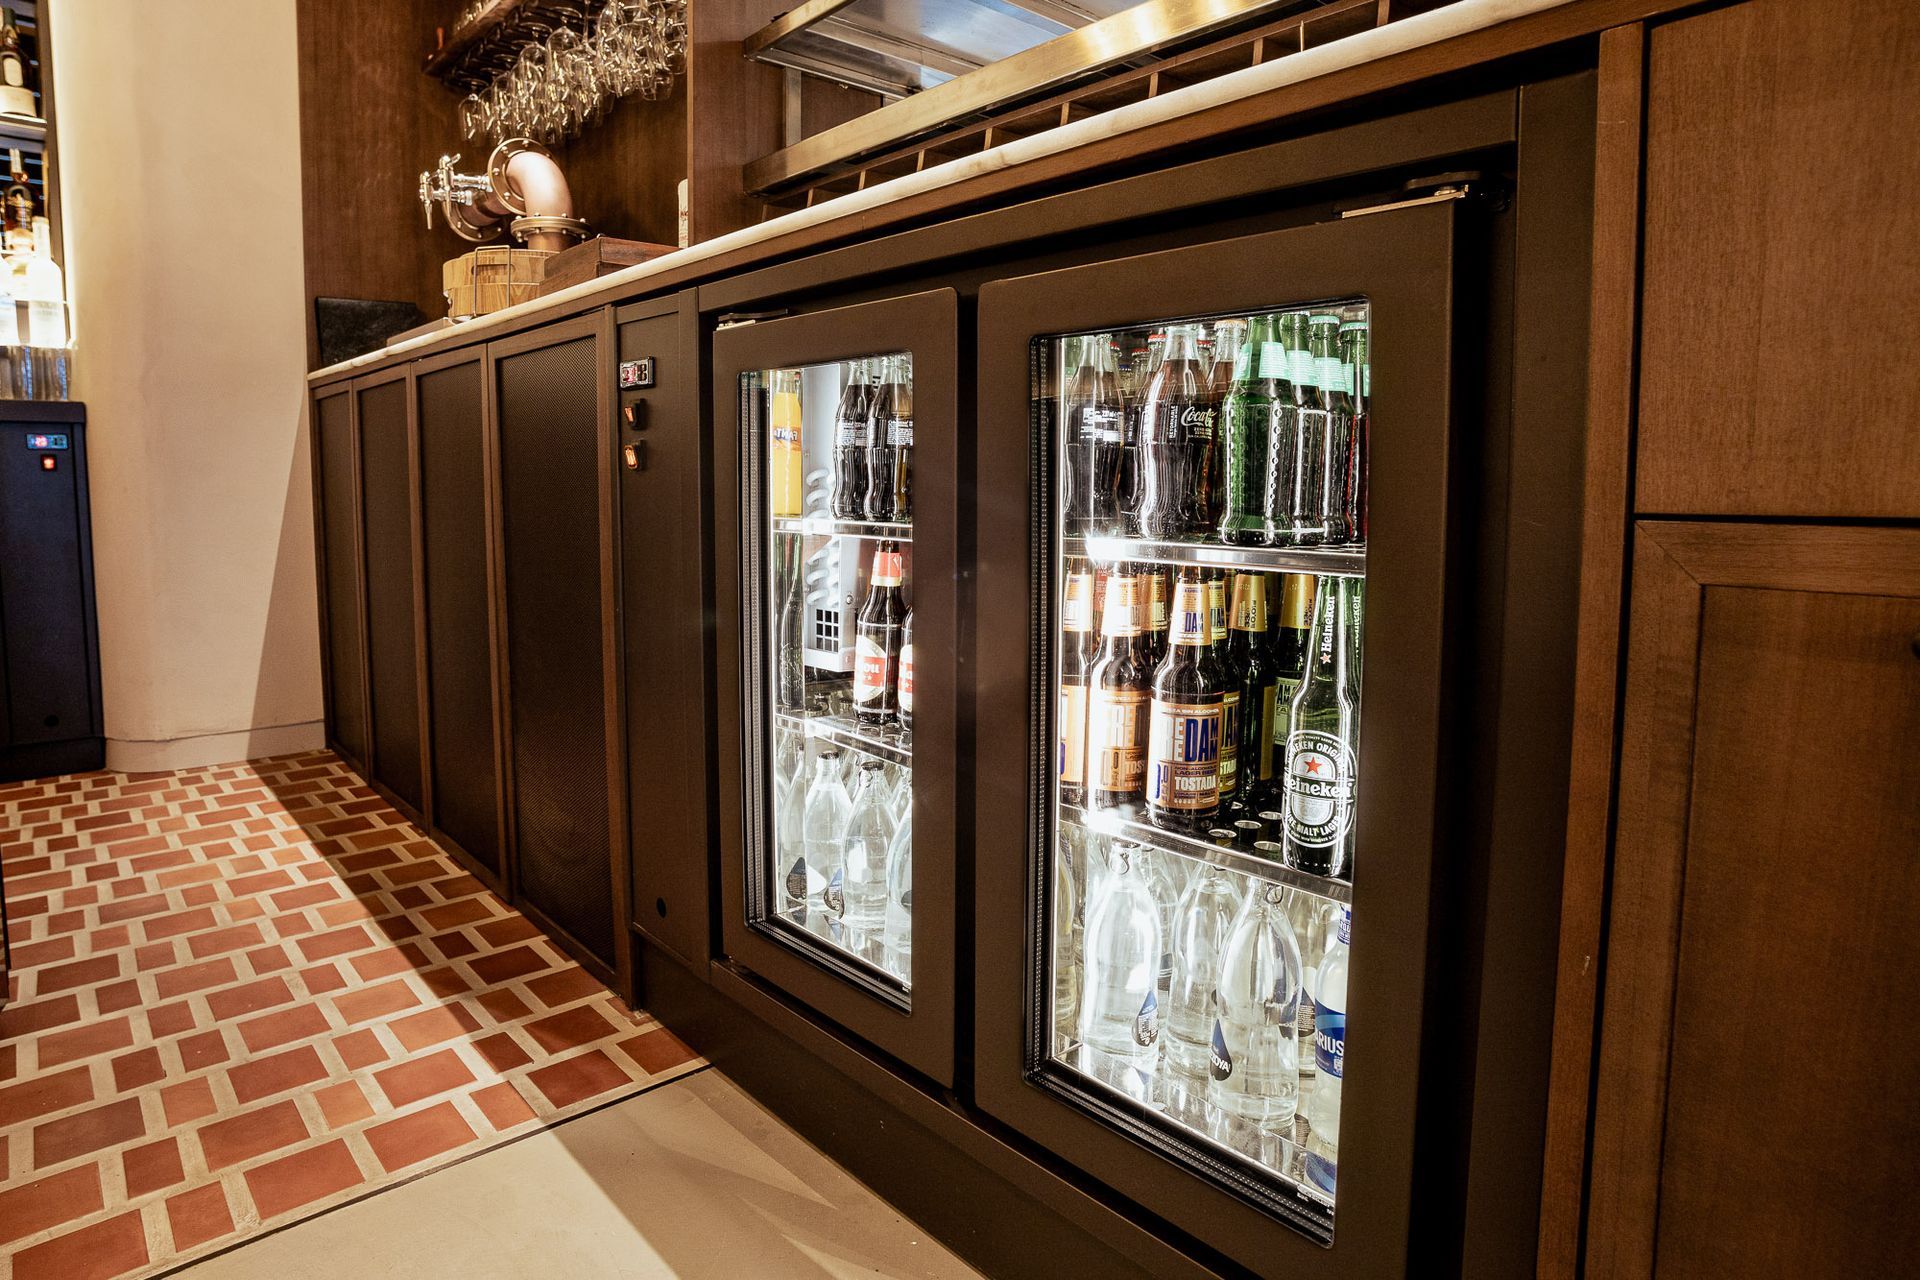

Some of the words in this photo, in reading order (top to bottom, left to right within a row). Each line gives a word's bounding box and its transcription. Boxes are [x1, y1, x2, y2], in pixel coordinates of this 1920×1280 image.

[1320, 595, 1336, 653] Heineken
[1174, 775, 1217, 791] TOSTADA
[1315, 1030, 1345, 1057] ARIUS
